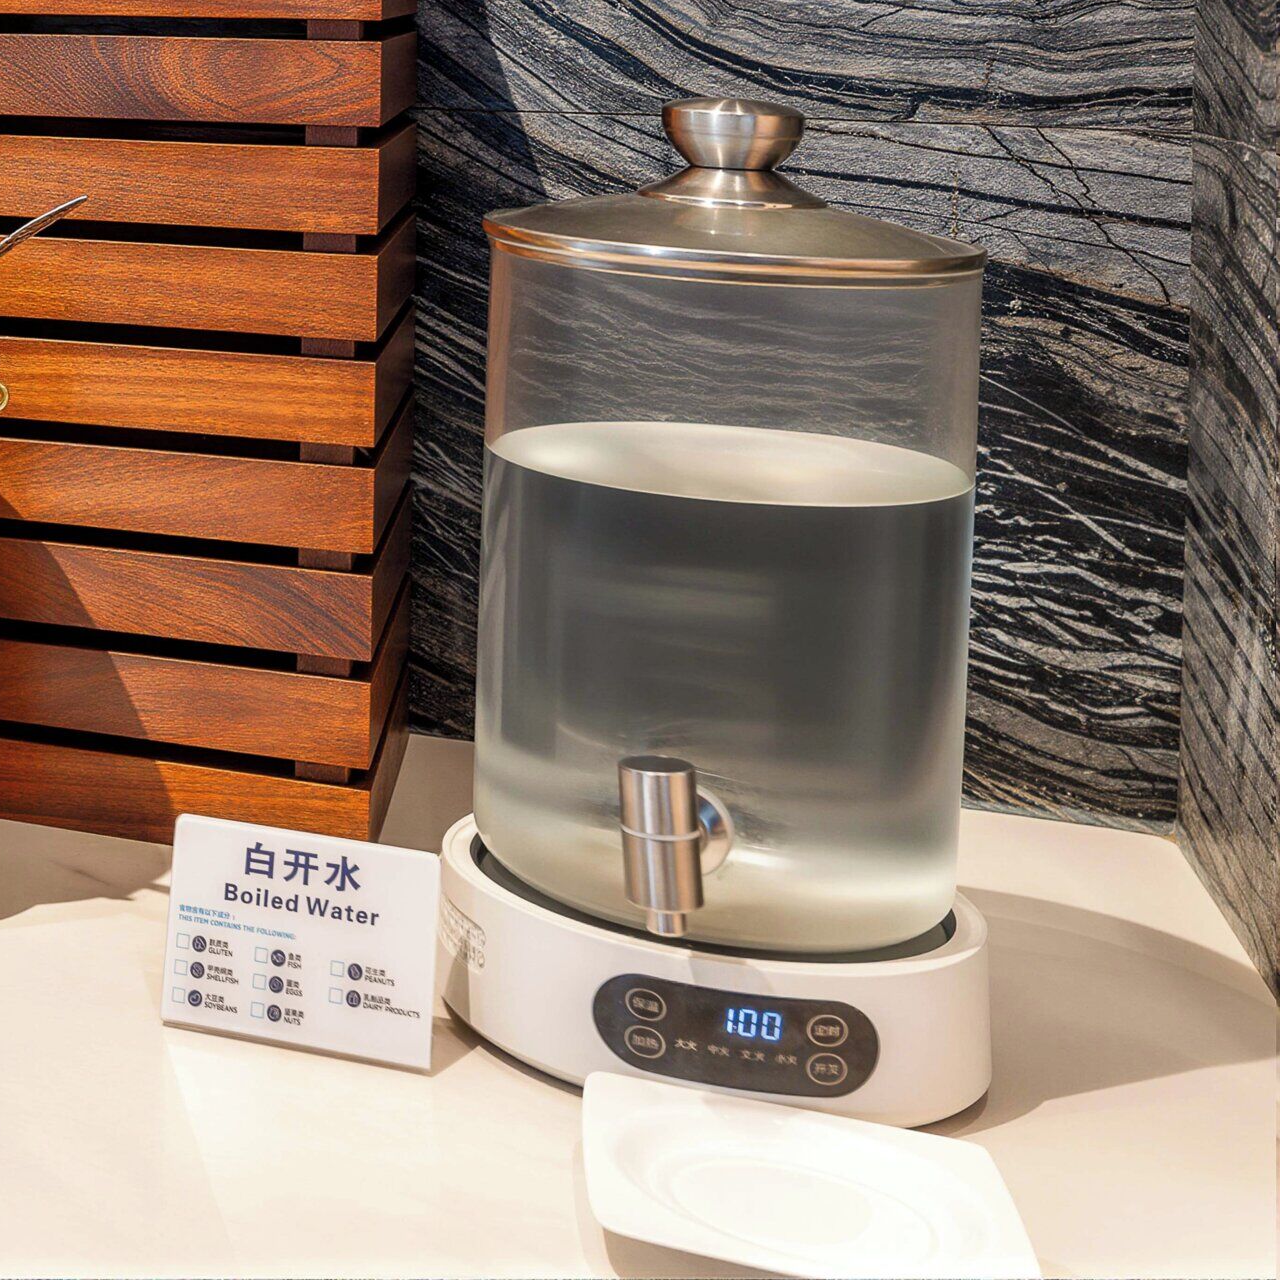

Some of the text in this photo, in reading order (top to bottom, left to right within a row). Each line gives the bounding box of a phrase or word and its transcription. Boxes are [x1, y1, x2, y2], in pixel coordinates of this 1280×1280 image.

[244, 842, 361, 892] 白开水
[224, 883, 379, 926] Boiled Water
[178, 914, 296, 940] THIS ITEM CONTAINS THE FOLLOWING:
[208, 947, 233, 957] GLUTEN
[288, 961, 302, 970] FISH
[206, 973, 239, 985] SHELLFISH
[365, 974, 395, 987] PEANUTS
[285, 987, 303, 997] EGGS
[204, 1001, 238, 1014] SOYBEANS
[363, 1002, 420, 1018] DAIRY PRODUCTS
[284, 1016, 301, 1026] NUTS
[726, 1008, 781, 1041] 100
[674, 1038, 697, 1052] 大火
